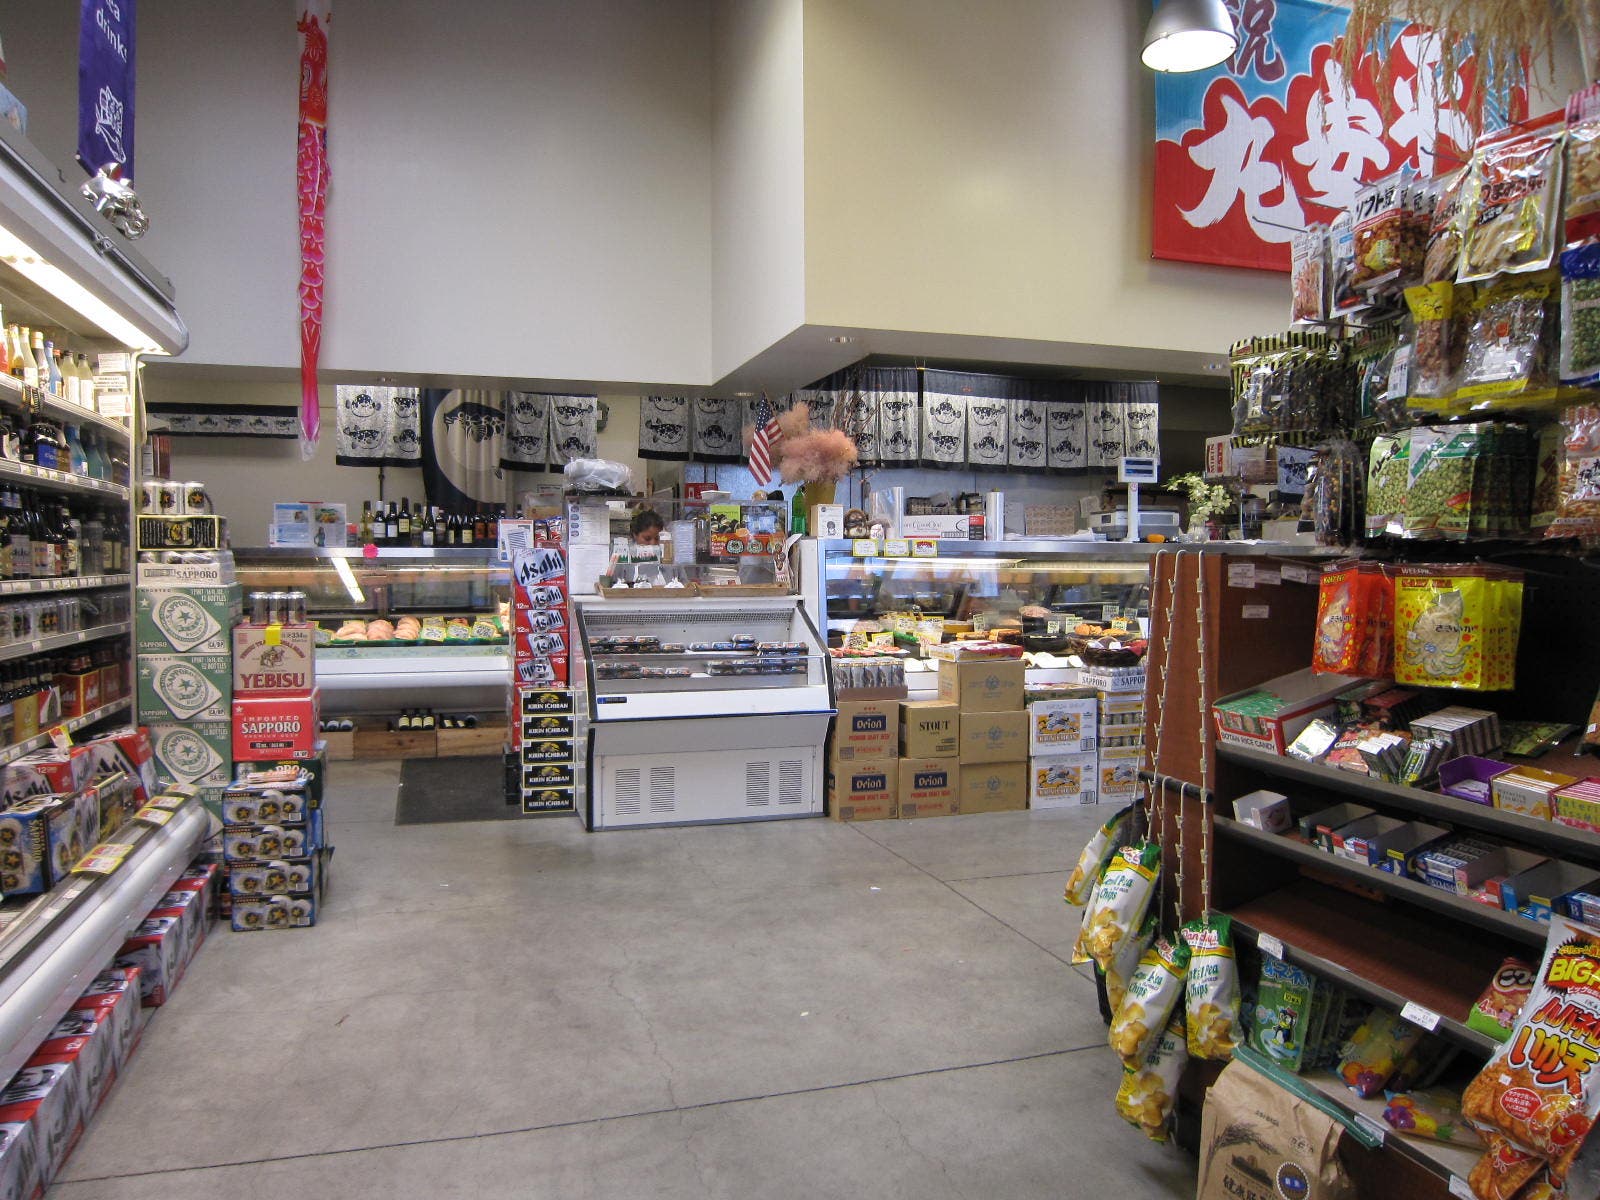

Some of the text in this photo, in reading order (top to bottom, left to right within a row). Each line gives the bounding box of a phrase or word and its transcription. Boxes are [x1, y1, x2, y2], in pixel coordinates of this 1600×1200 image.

[520, 551, 563, 584] Asahi
[176, 570, 218, 579] SAPPORO
[535, 589, 561, 604] Asahi
[535, 612, 562, 628] Asahi
[536, 635, 562, 652] Asahi
[240, 673, 305, 688] YEBISU
[1082, 677, 1107, 688] SAPPORO
[1121, 675, 1146, 687] SAPPOR
[241, 721, 302, 734] SAPPORO
[856, 718, 882, 729] Orion
[919, 720, 950, 731] STOUT
[1221, 731, 1275, 751] BOTAN RICE CANDY
[856, 779, 882, 789] Orion
[918, 775, 943, 786] Orion
[1204, 963, 1219, 977] Pea
[1190, 982, 1208, 998] Chips
